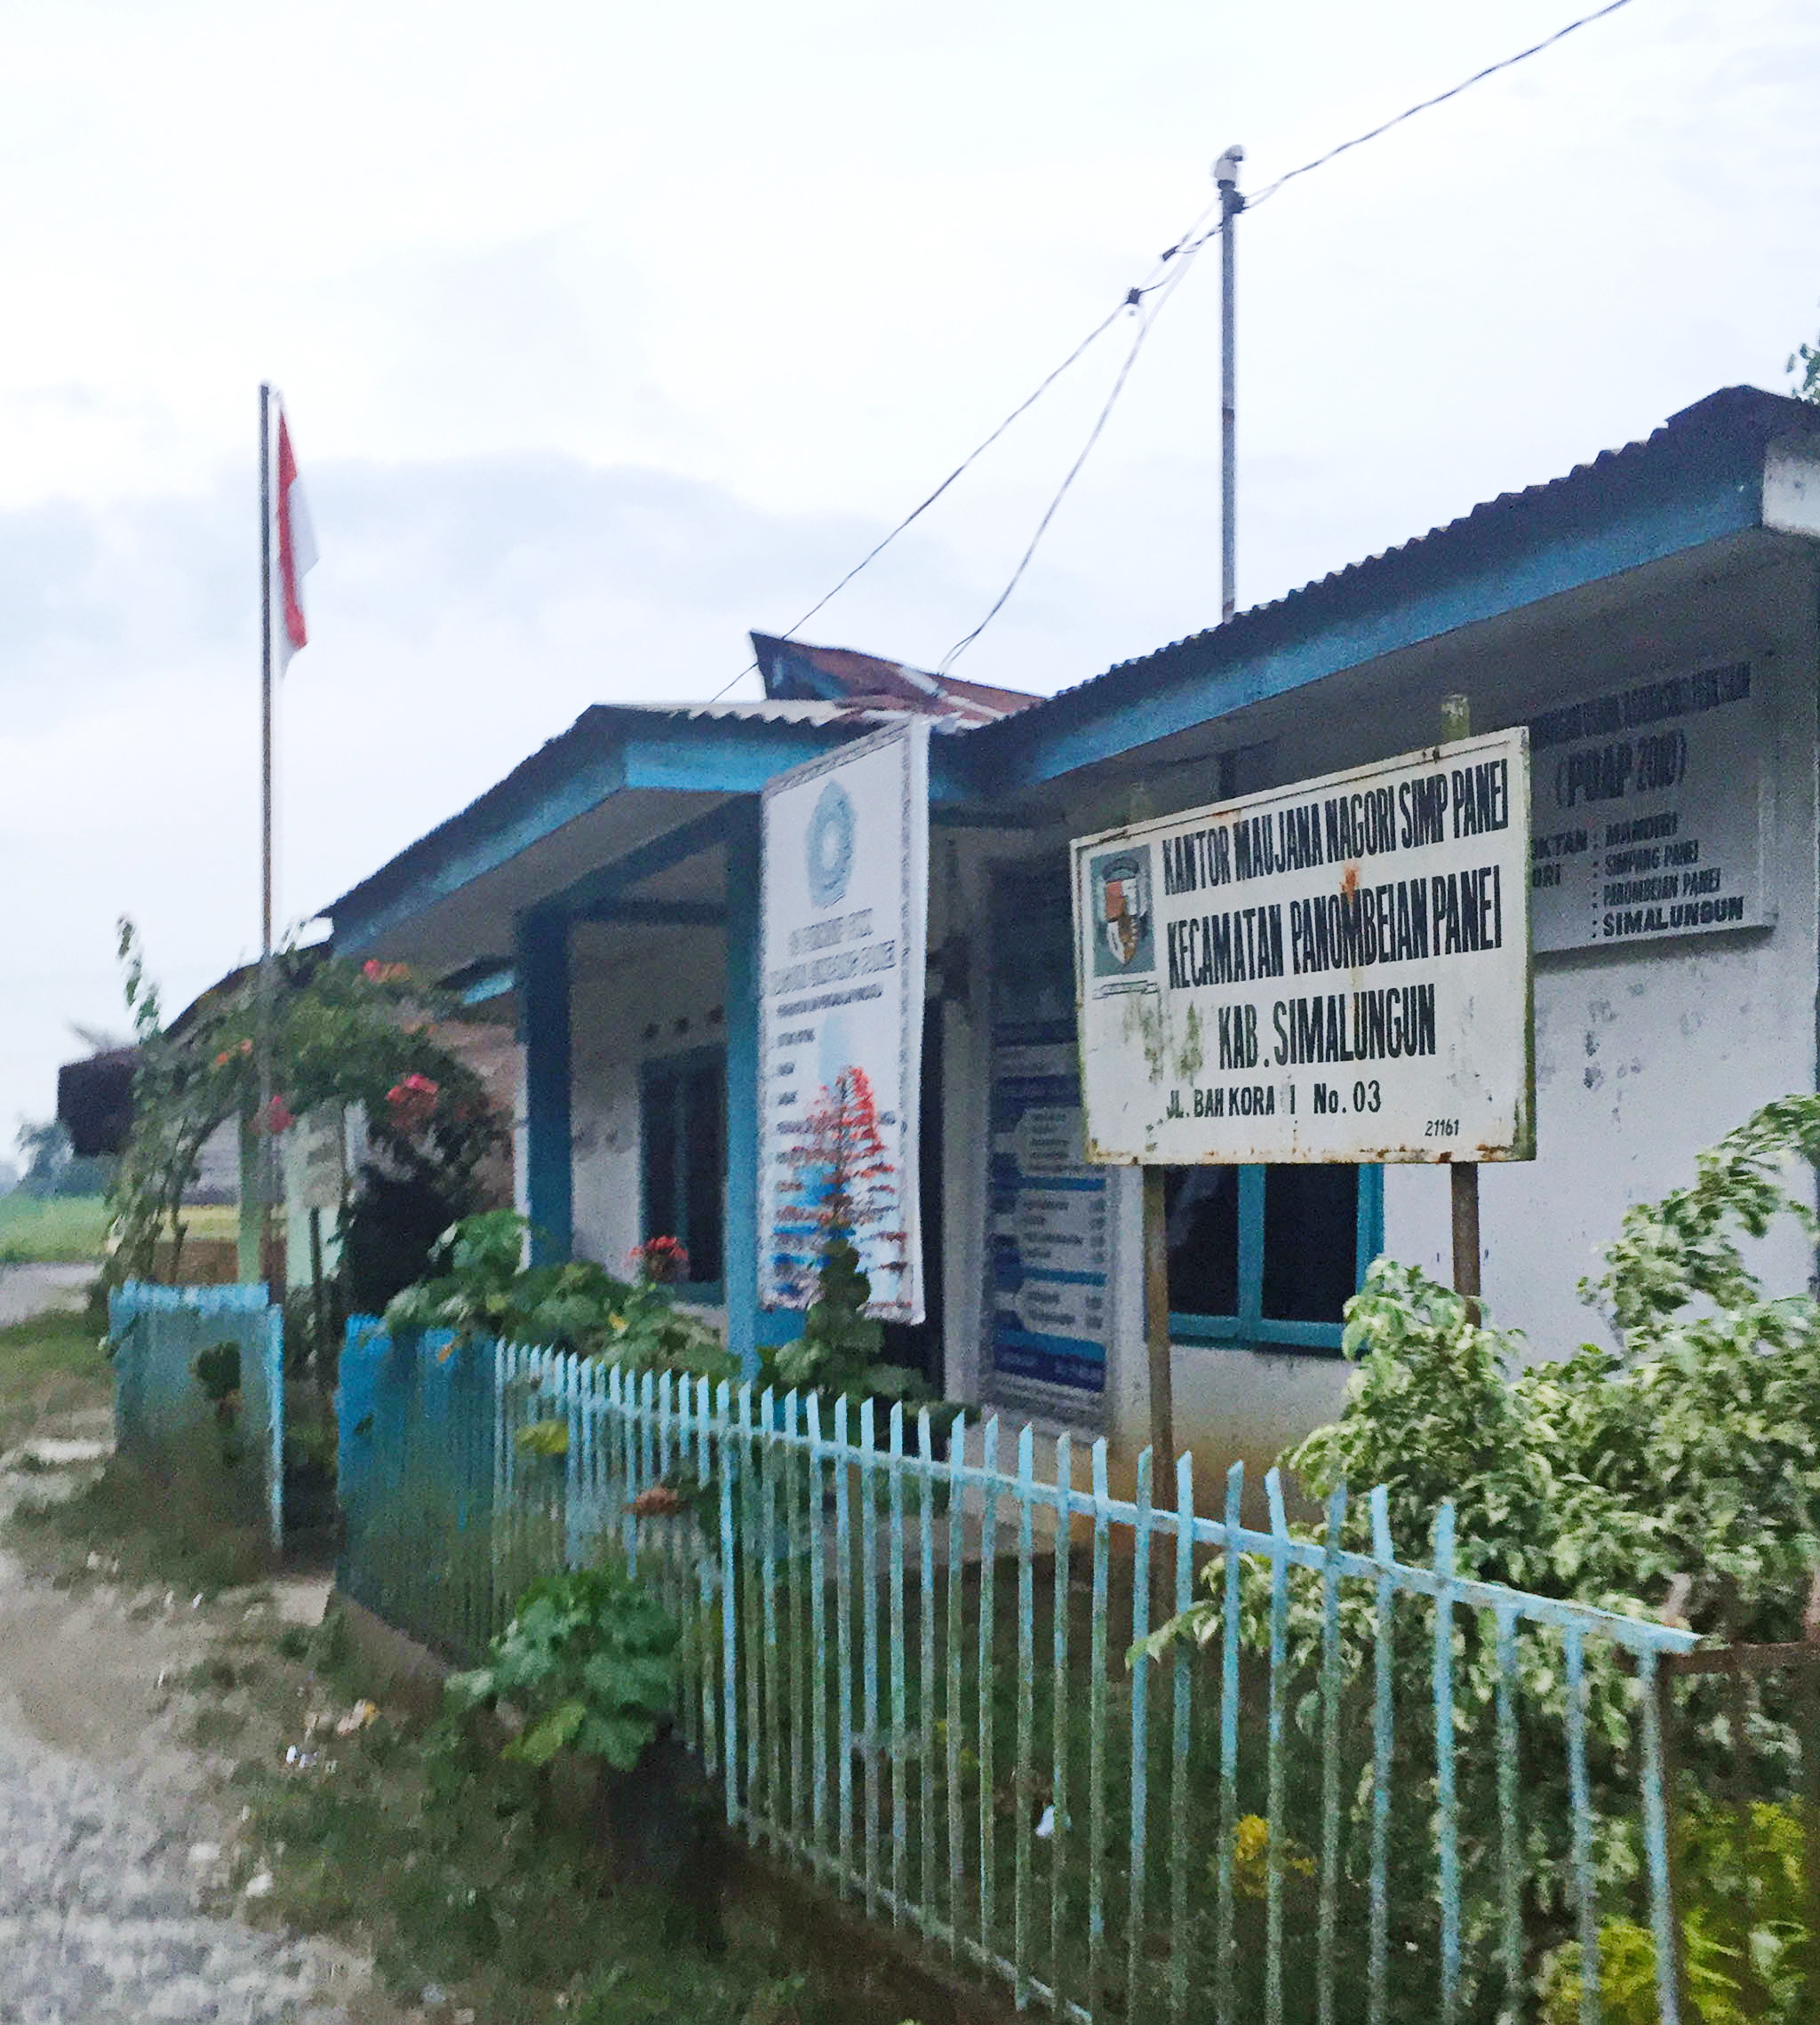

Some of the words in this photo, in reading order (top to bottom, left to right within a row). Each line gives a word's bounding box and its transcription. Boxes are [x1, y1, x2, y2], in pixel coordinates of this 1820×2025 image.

[1162, 830, 1230, 896] KANTOR
[1233, 801, 1324, 882] MAUJANA
[1325, 785, 1396, 864] NAGORI
[1399, 773, 1448, 849] SIMP
[1453, 758, 1509, 839] PANEI
[1167, 904, 1284, 989] KECAMATAN
[1290, 876, 1429, 975] PANOMBEIAN
[1432, 864, 1503, 955] PANEI
[1602, 896, 1744, 937] SIMALUNGUN
[1218, 1003, 1270, 1070] KAB.
[1273, 983, 1436, 1065] SIMALUNGUN
[1193, 1087, 1225, 1118] BAH
[1228, 1085, 1275, 1117] KORA
[1313, 1082, 1348, 1115] No.
[1353, 1080, 1382, 1113] 03
[1425, 1119, 1460, 1137] 21161
